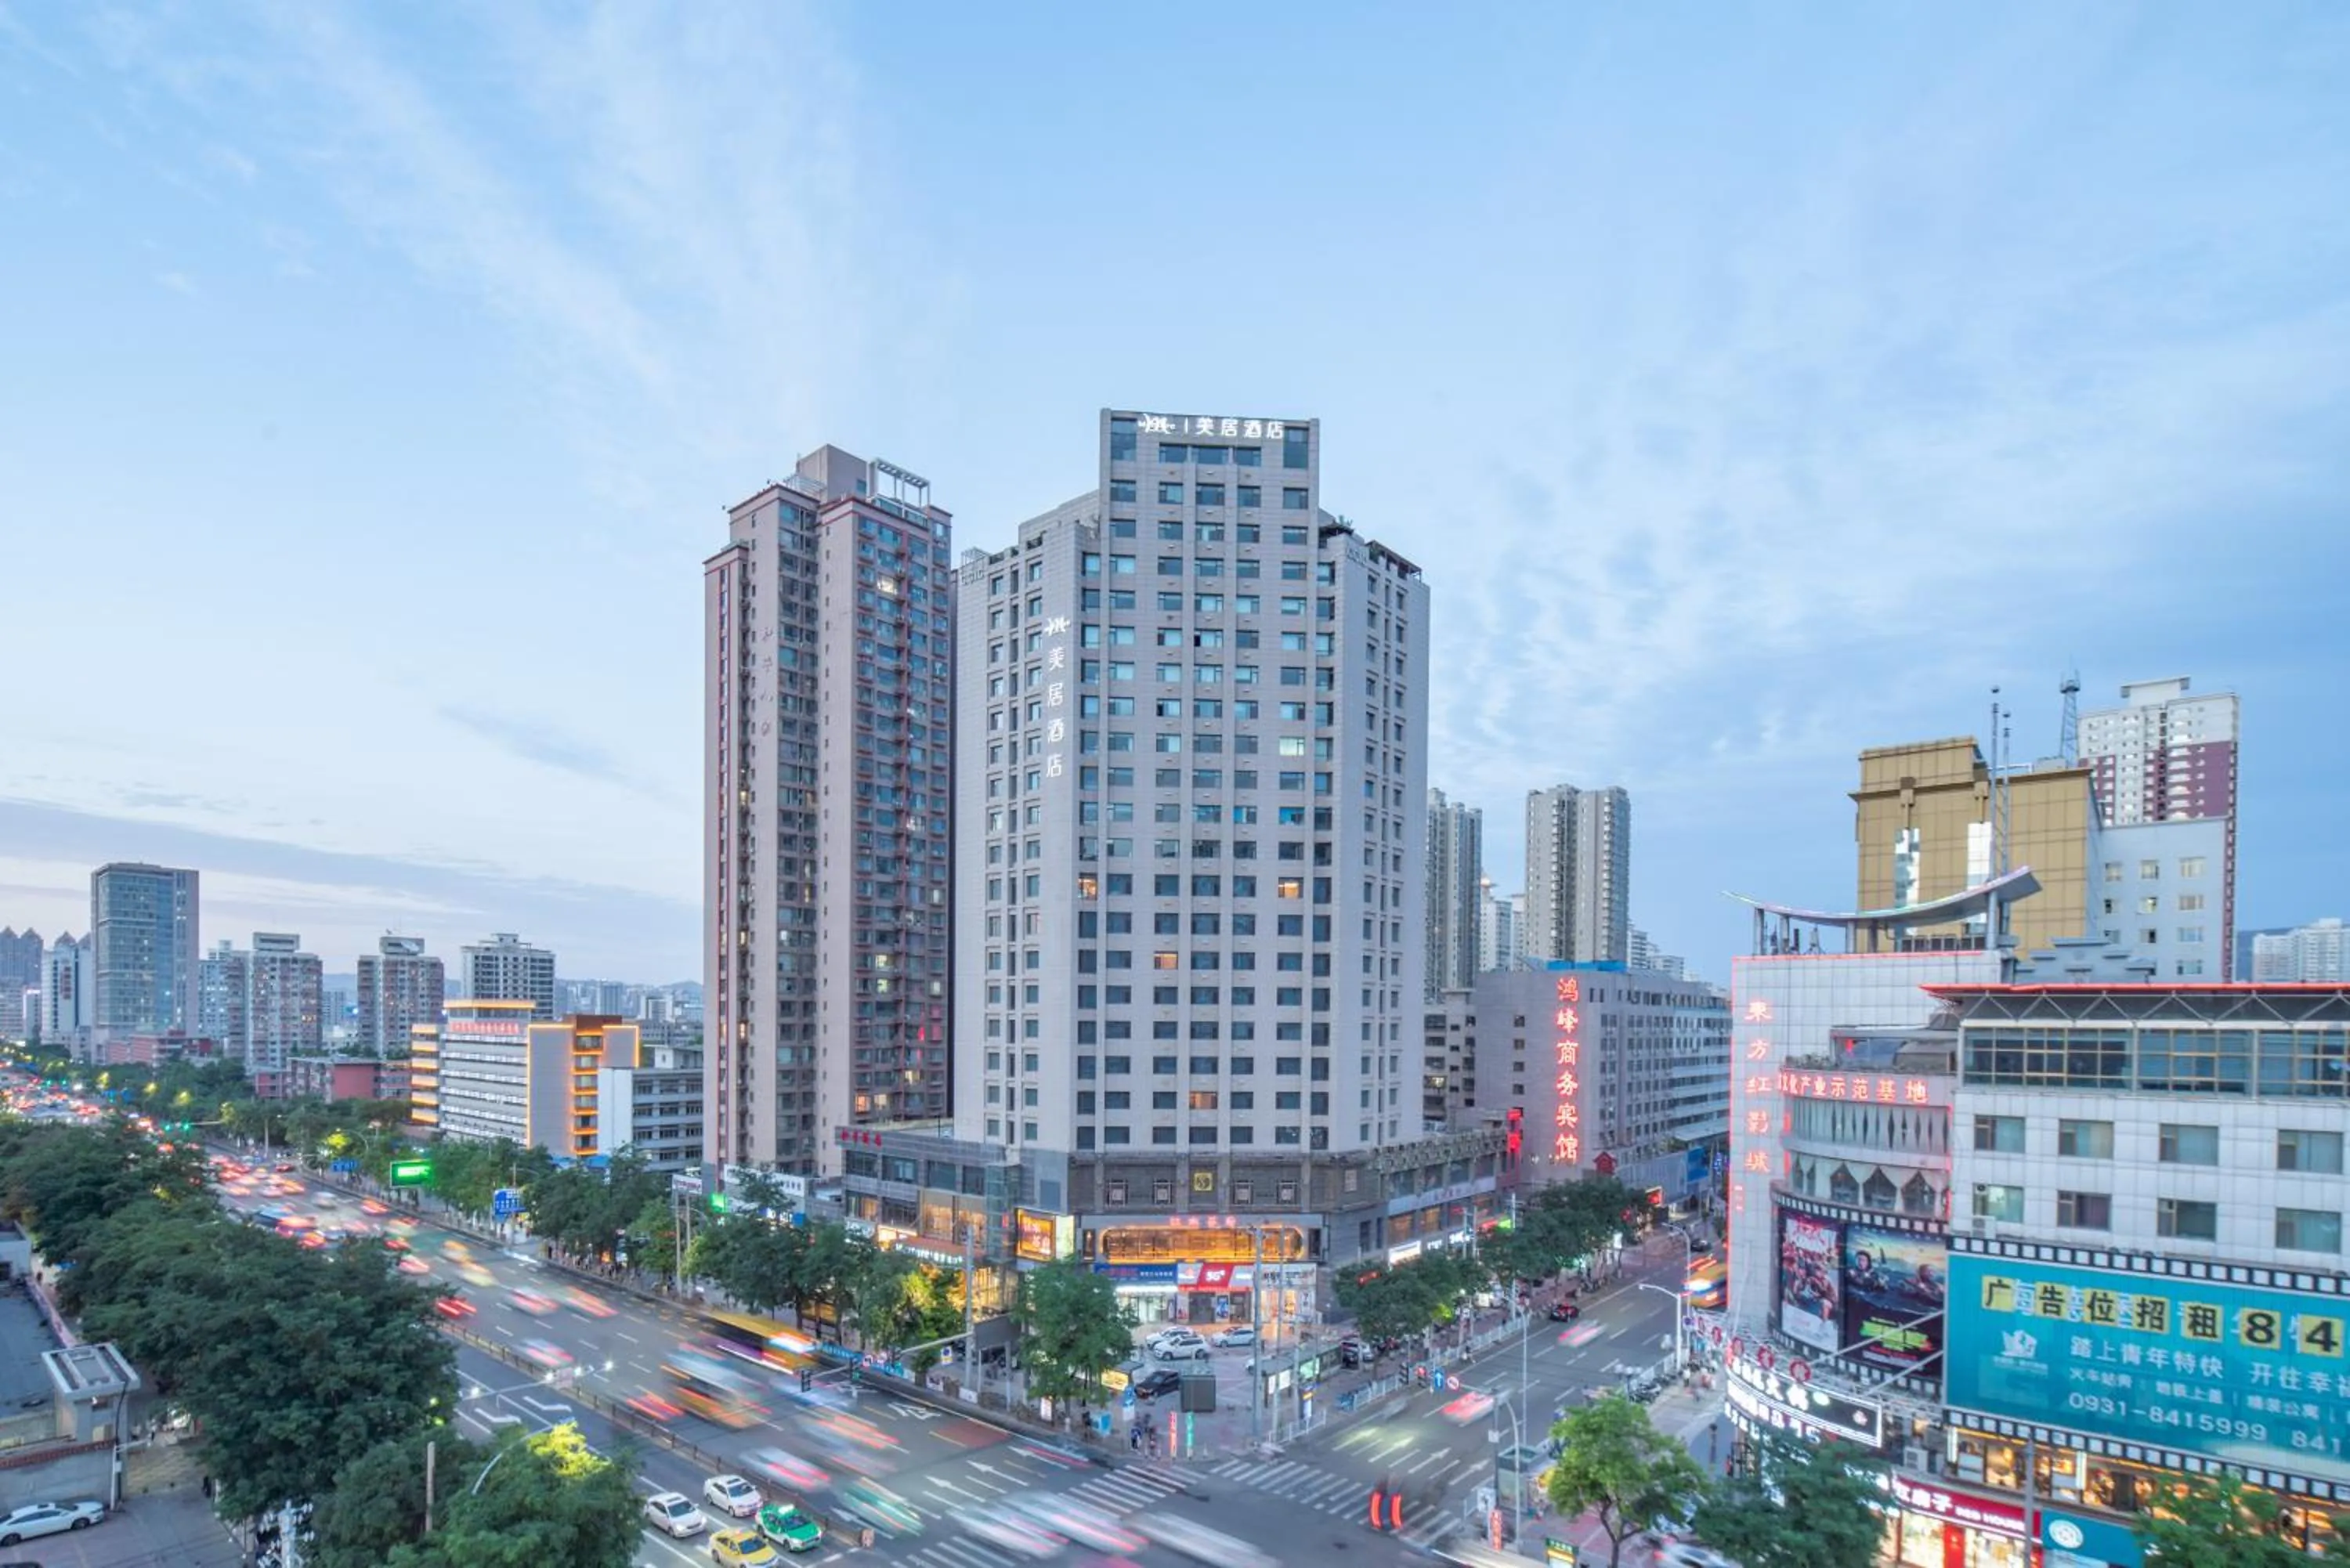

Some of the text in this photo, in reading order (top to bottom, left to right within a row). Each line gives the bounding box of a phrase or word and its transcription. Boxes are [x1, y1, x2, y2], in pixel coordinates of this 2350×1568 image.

[1195, 417, 1285, 439] 美居酒店
[1046, 647, 1065, 778] 美居酒店
[1556, 978, 1578, 1162] 鸿峰商务宾馆
[2069, 1392, 2267, 1441] 0931-8415999
